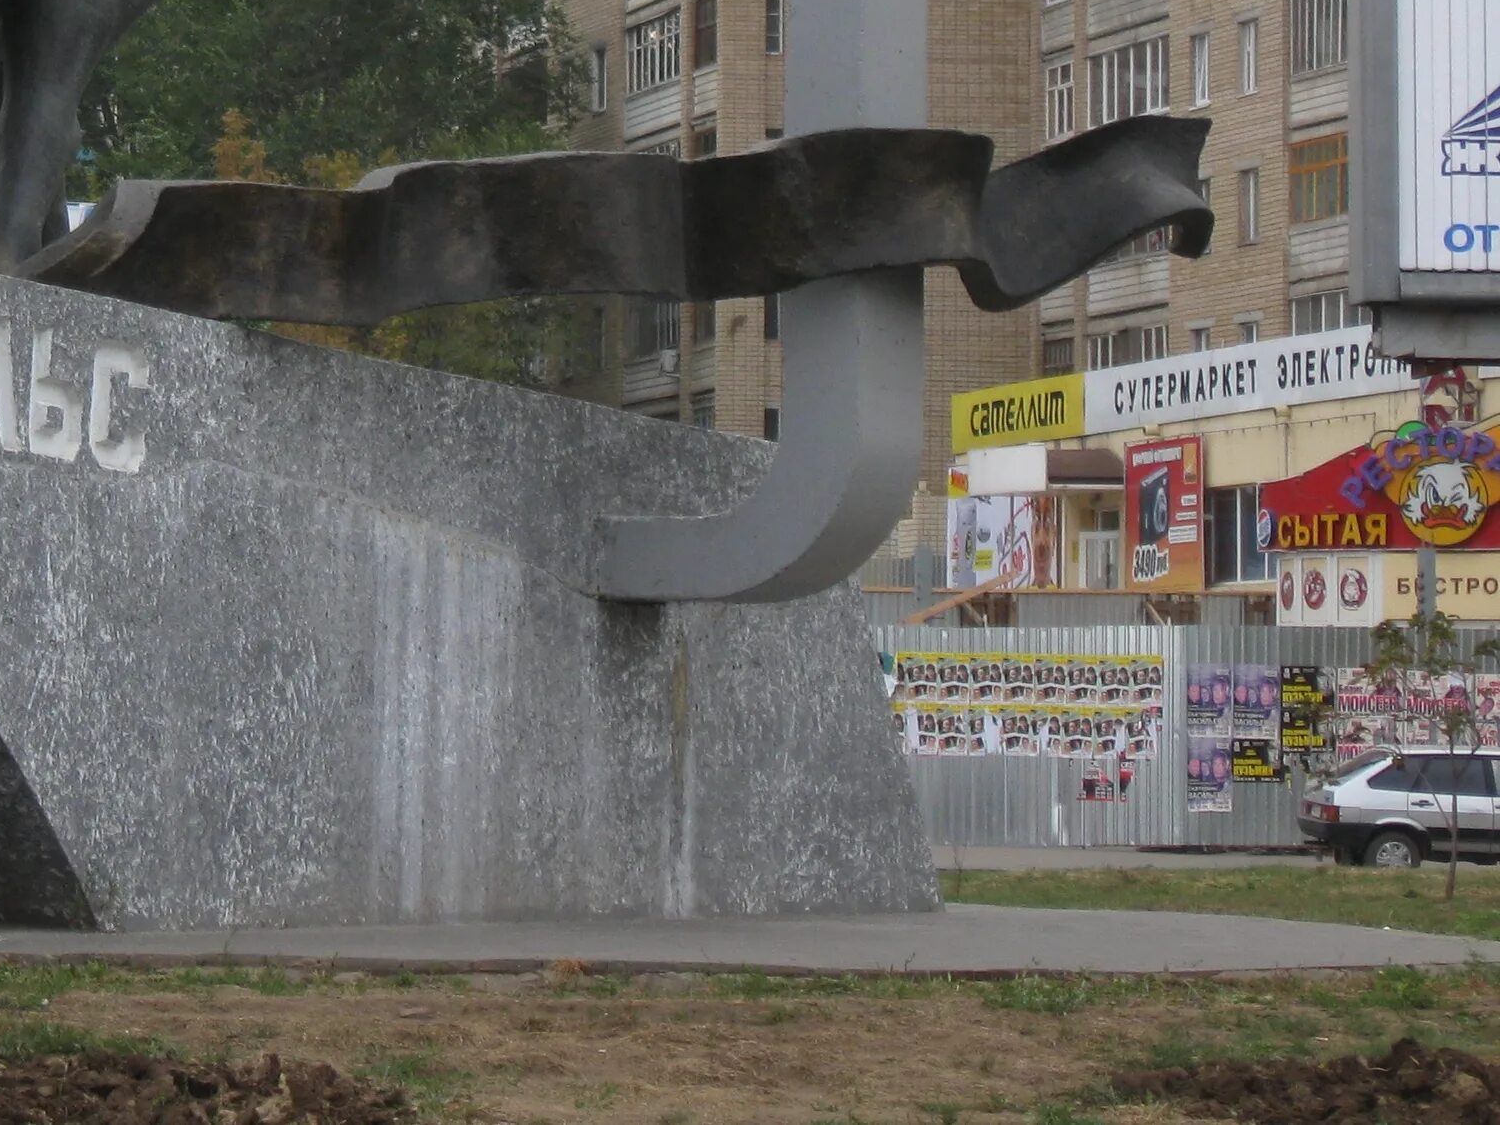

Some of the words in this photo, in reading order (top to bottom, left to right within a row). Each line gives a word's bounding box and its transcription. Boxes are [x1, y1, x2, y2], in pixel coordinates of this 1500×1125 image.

[1114, 359, 1257, 415] СУПЕРМАРКЕТ
[1278, 513, 1387, 548] СЫТАЯ
[1134, 548, 1156, 578] 3490
[1396, 577, 1499, 595] БСТРО
